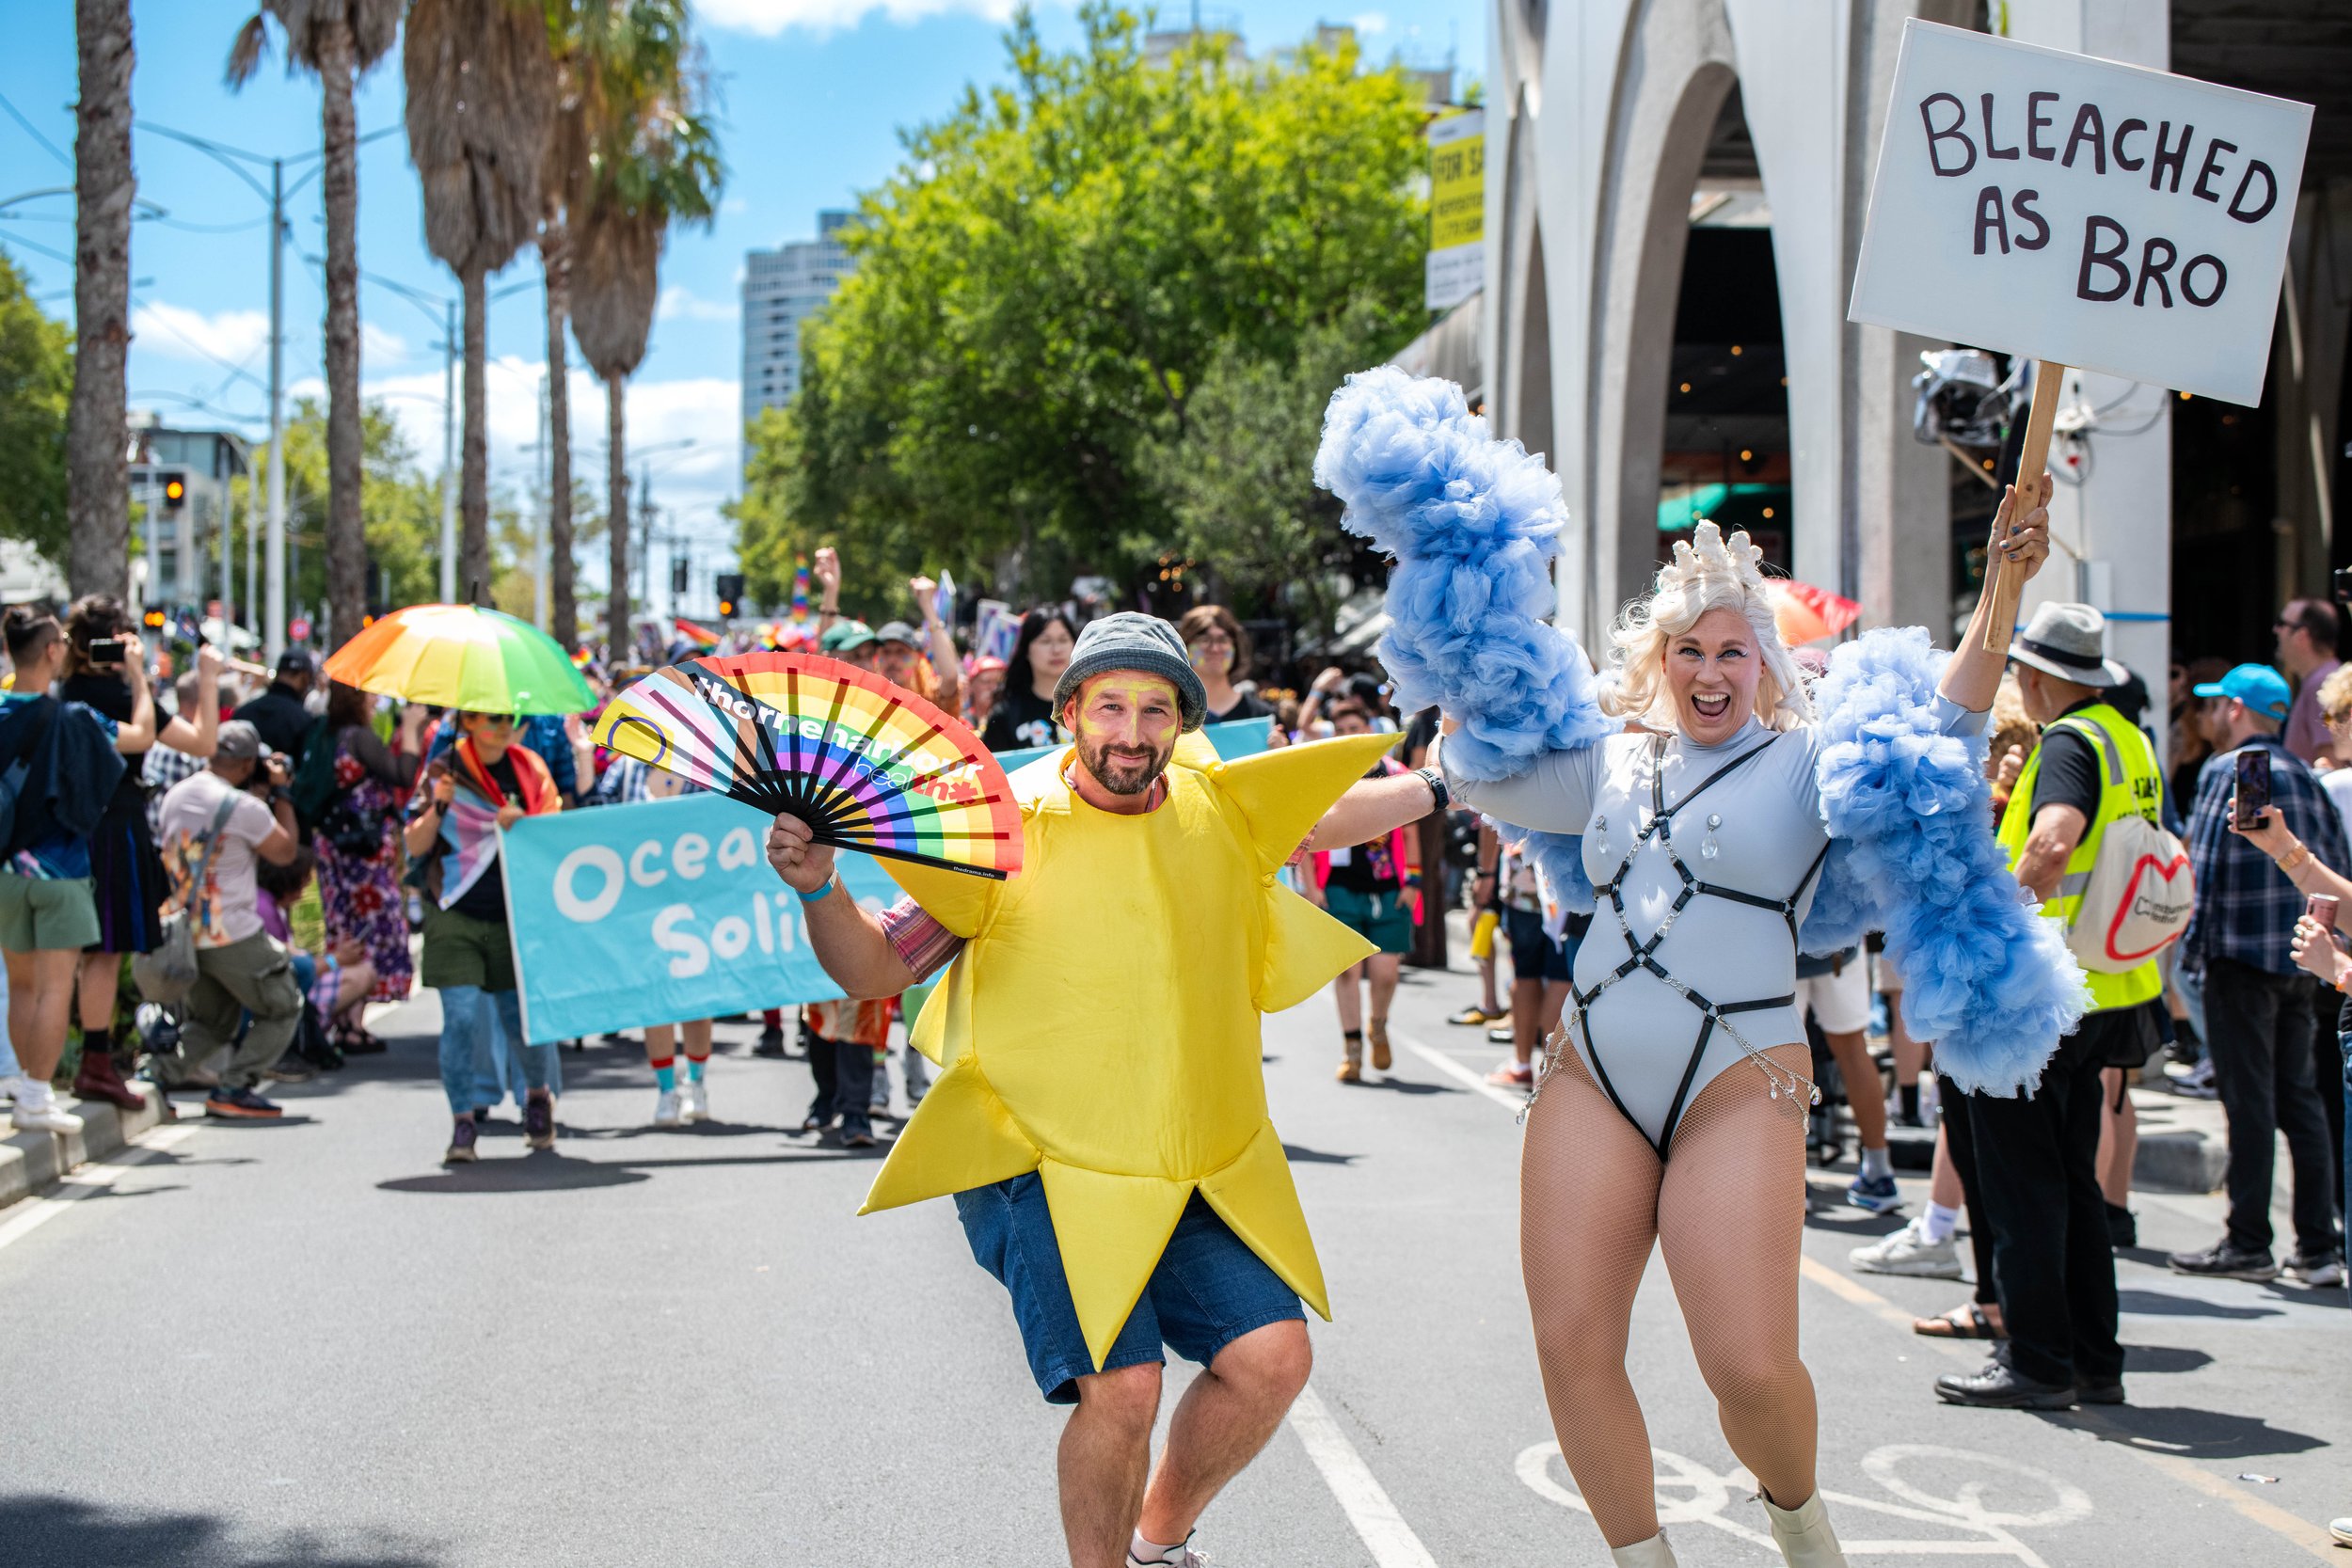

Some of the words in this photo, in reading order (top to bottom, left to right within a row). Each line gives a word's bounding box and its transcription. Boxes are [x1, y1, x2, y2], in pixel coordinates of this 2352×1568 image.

[1919, 91, 2278, 224] BLEACHED
[1973, 185, 2051, 255] AS
[2076, 214, 2228, 309] BRO
[693, 675, 984, 782] thorneharbour
[552, 826, 774, 923] Ocea
[953, 865, 995, 879] thedrama.info
[651, 891, 813, 979] Soli
